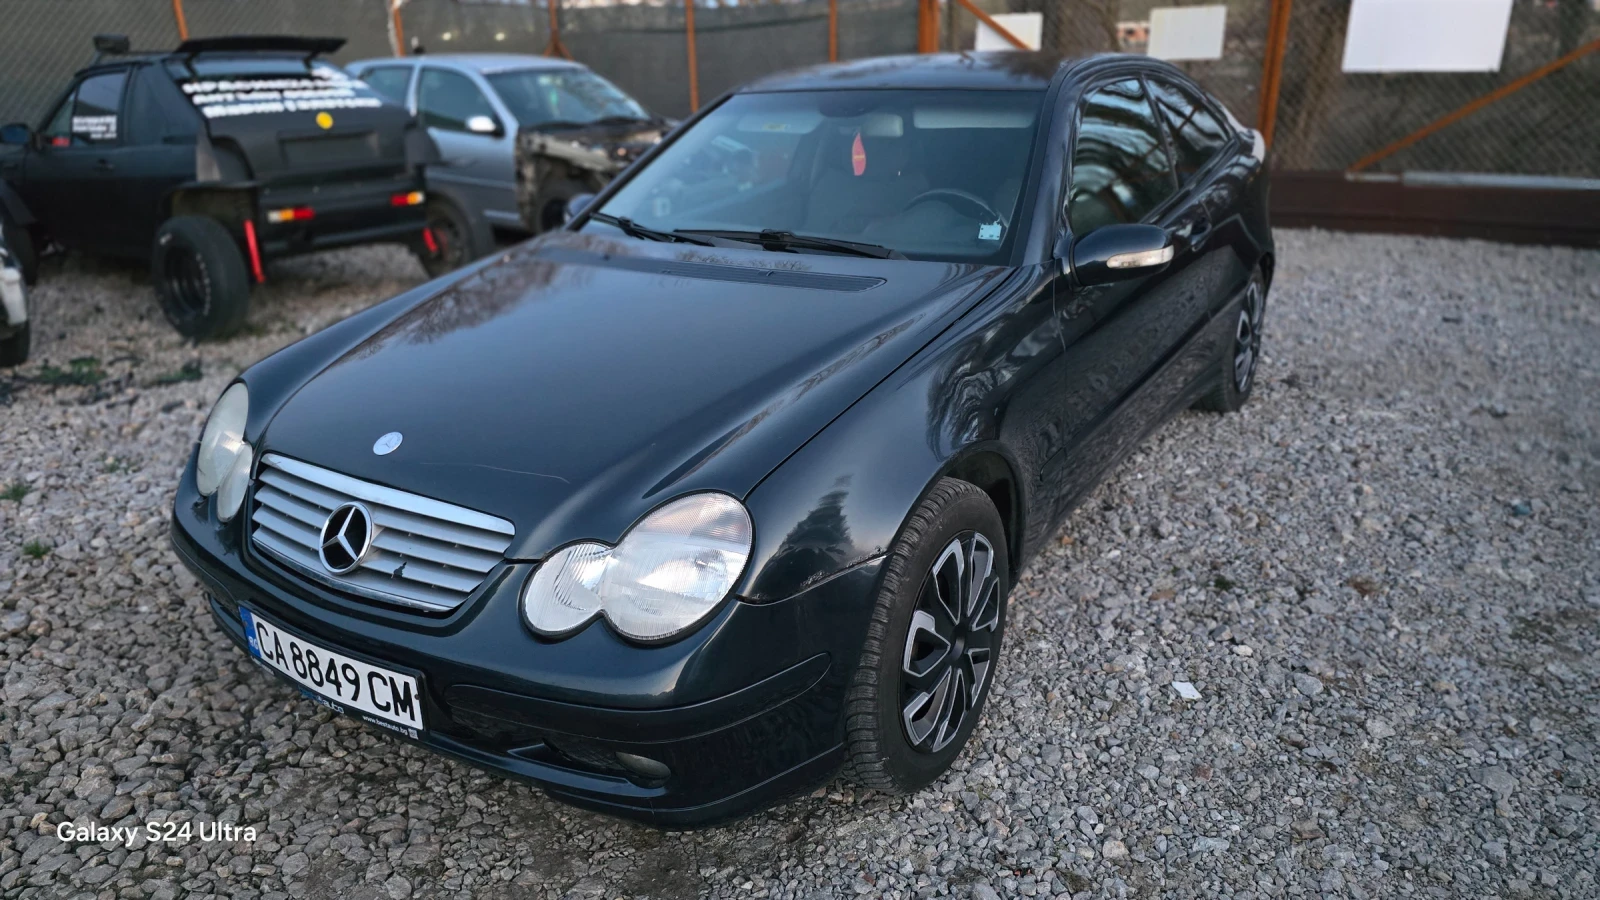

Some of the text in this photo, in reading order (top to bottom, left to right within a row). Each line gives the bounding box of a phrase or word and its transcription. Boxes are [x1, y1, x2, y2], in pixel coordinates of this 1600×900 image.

[256, 621, 290, 671] CA
[289, 641, 361, 702] 8849
[367, 671, 416, 722] CM
[361, 714, 408, 736] www.bestauto.bg
